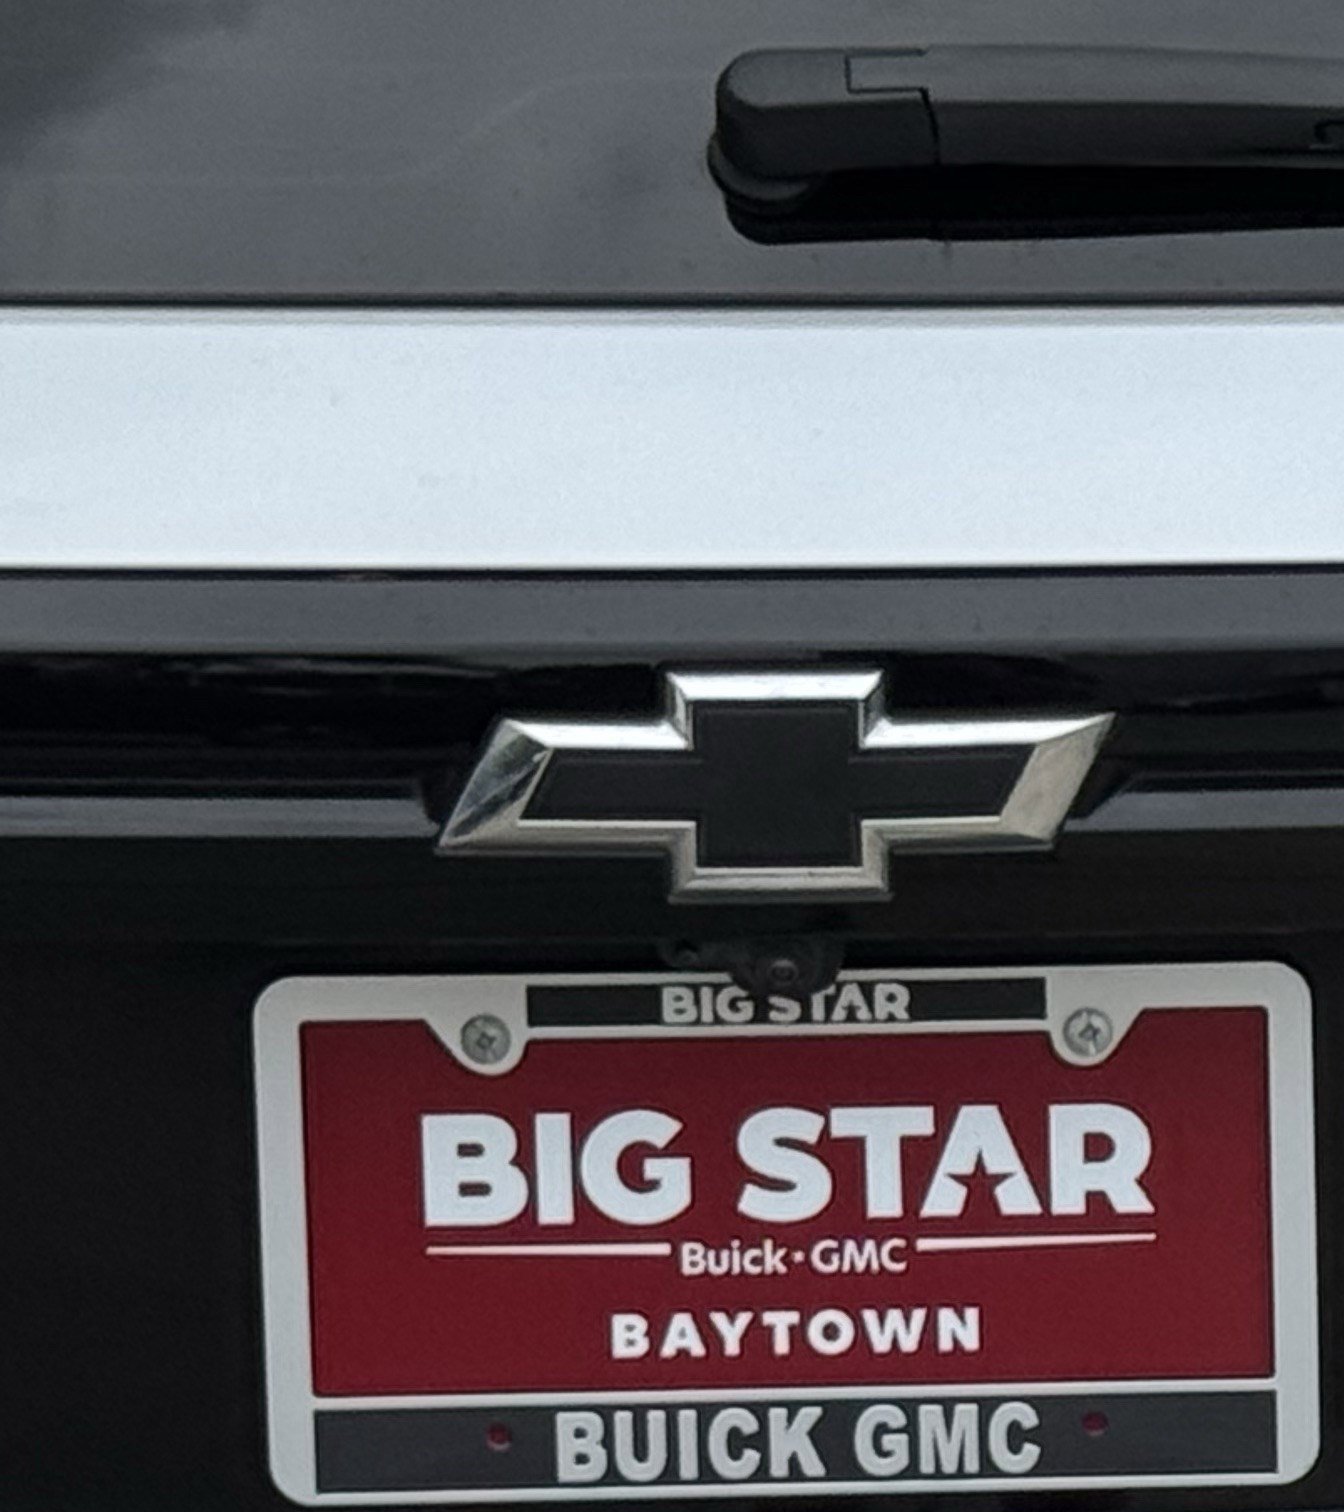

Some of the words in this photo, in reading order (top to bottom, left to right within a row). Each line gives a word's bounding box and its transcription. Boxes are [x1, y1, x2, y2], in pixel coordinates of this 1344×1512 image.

[661, 985, 755, 1024] BIG
[767, 981, 911, 1023] STAR
[421, 1109, 692, 1227] BIG
[737, 1103, 1155, 1223] STAR
[610, 1306, 981, 1360] BAYTOWN
[554, 1405, 827, 1484] BUICK
[853, 1401, 1042, 1477] GMC
